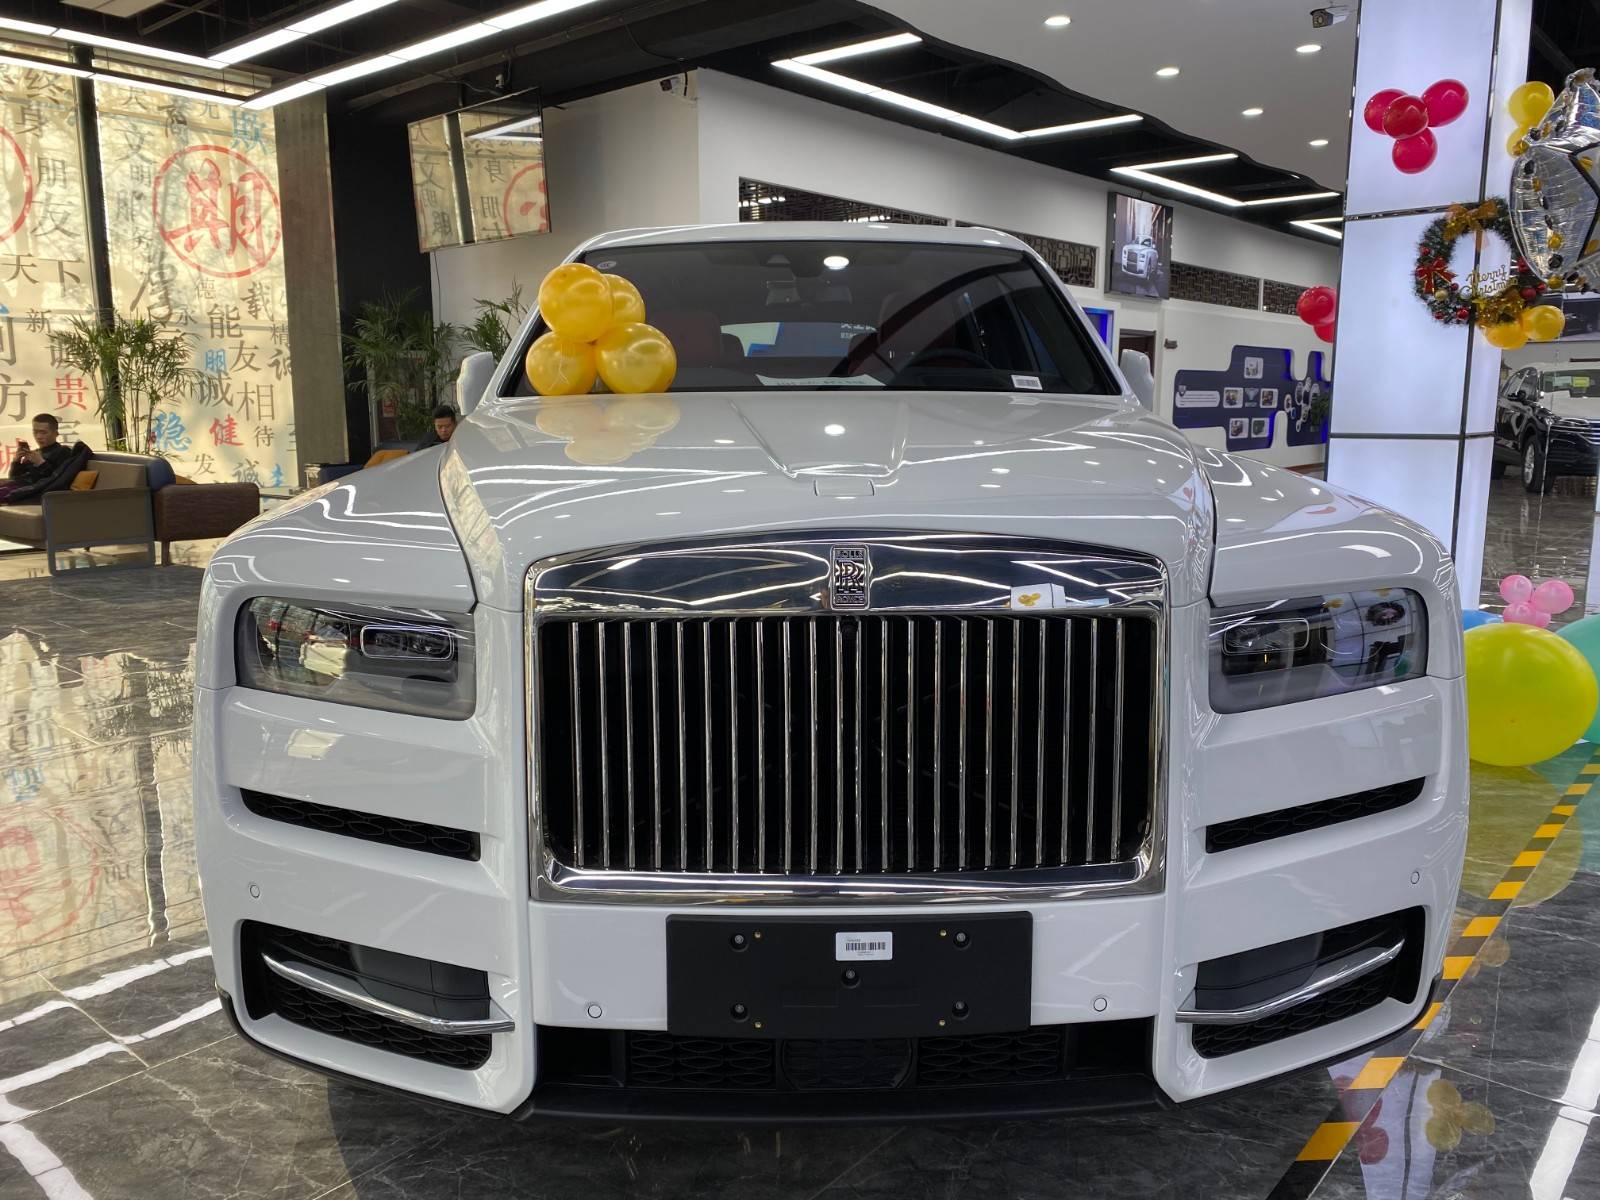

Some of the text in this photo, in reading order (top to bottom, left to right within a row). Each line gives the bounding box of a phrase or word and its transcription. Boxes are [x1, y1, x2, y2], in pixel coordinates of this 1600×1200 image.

[0, 253, 82, 297] 天下
[25, 308, 51, 333] 新
[207, 303, 243, 339] 能
[229, 340, 262, 373] 友
[51, 374, 88, 411] 贵
[236, 381, 275, 421] 相
[209, 414, 244, 447] 健
[254, 425, 274, 447] 待
